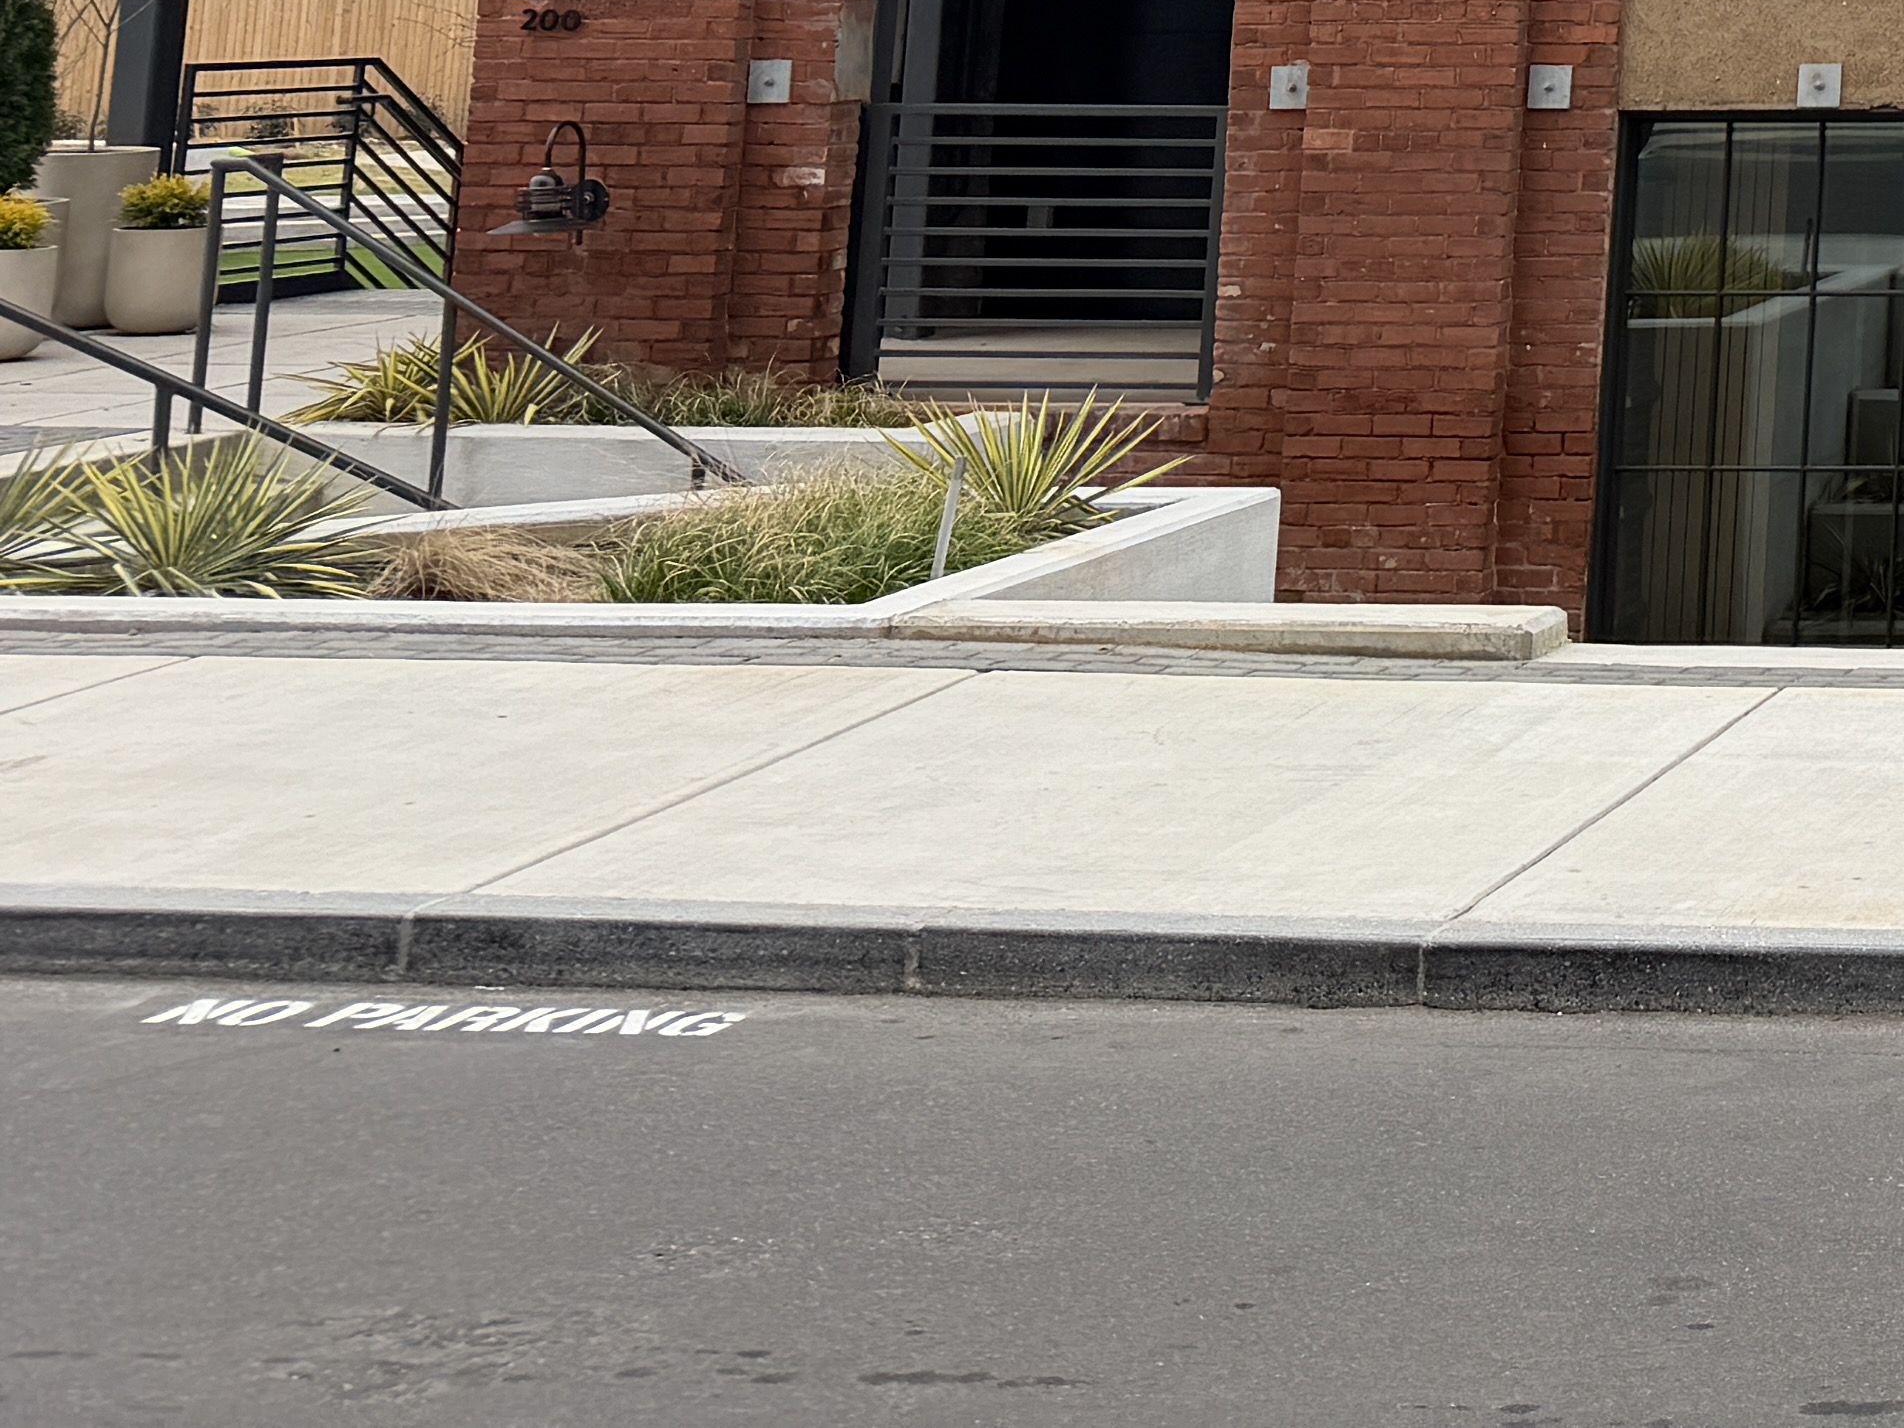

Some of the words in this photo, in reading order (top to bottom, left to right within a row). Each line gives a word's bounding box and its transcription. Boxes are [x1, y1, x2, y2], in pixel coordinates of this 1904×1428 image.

[520, 9, 582, 31] 200
[140, 998, 313, 1026] NO
[304, 1001, 751, 1037] PARKING
